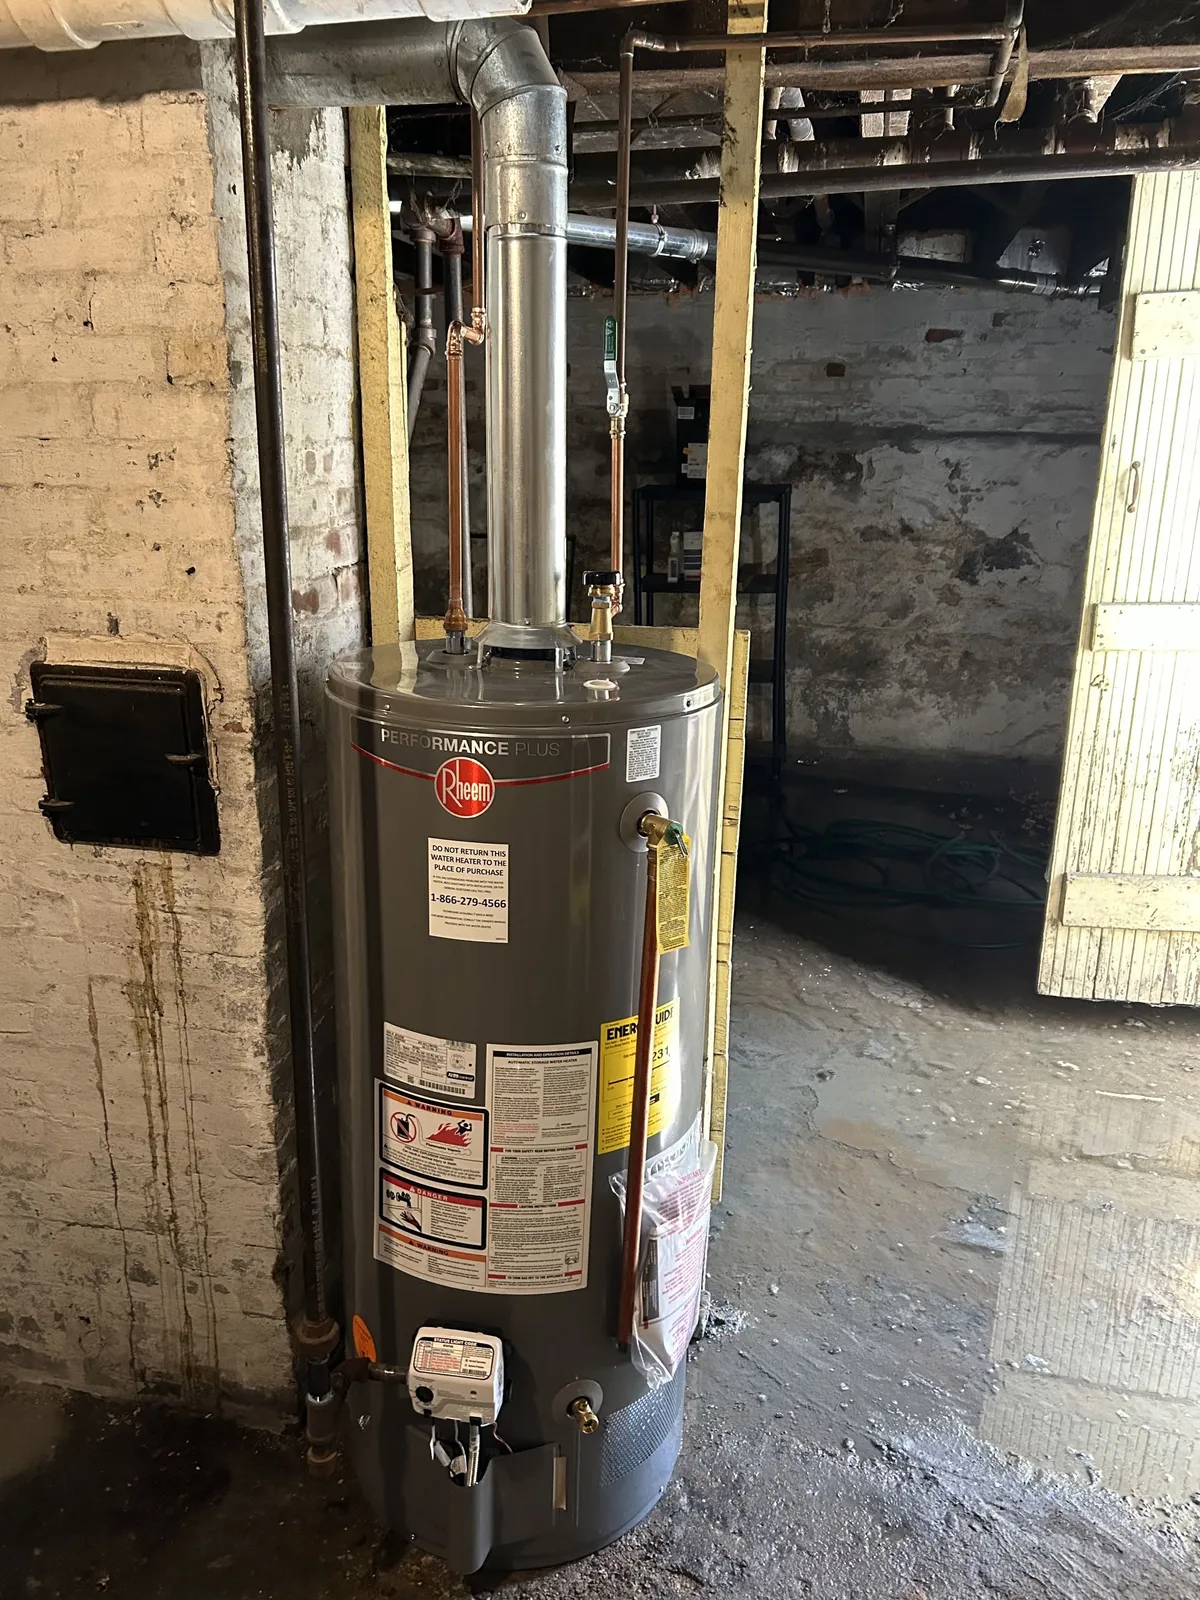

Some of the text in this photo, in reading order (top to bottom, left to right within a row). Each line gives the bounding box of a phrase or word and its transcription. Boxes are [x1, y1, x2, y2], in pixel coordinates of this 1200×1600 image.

[381, 728, 560, 757] PERFORMANCE PLUS
[442, 759, 491, 808] Rheem
[432, 844, 507, 858] DO NOT RETURN THIS
[430, 853, 454, 863] WATER
[455, 856, 482, 866] HEATER
[434, 864, 504, 877] PLACE OF PURCHASE
[430, 893, 507, 909] 1-866-279-4566
[415, 1102, 453, 1116] WARNING
[417, 1190, 448, 1201] DANGER
[417, 1242, 449, 1256] WARNING
